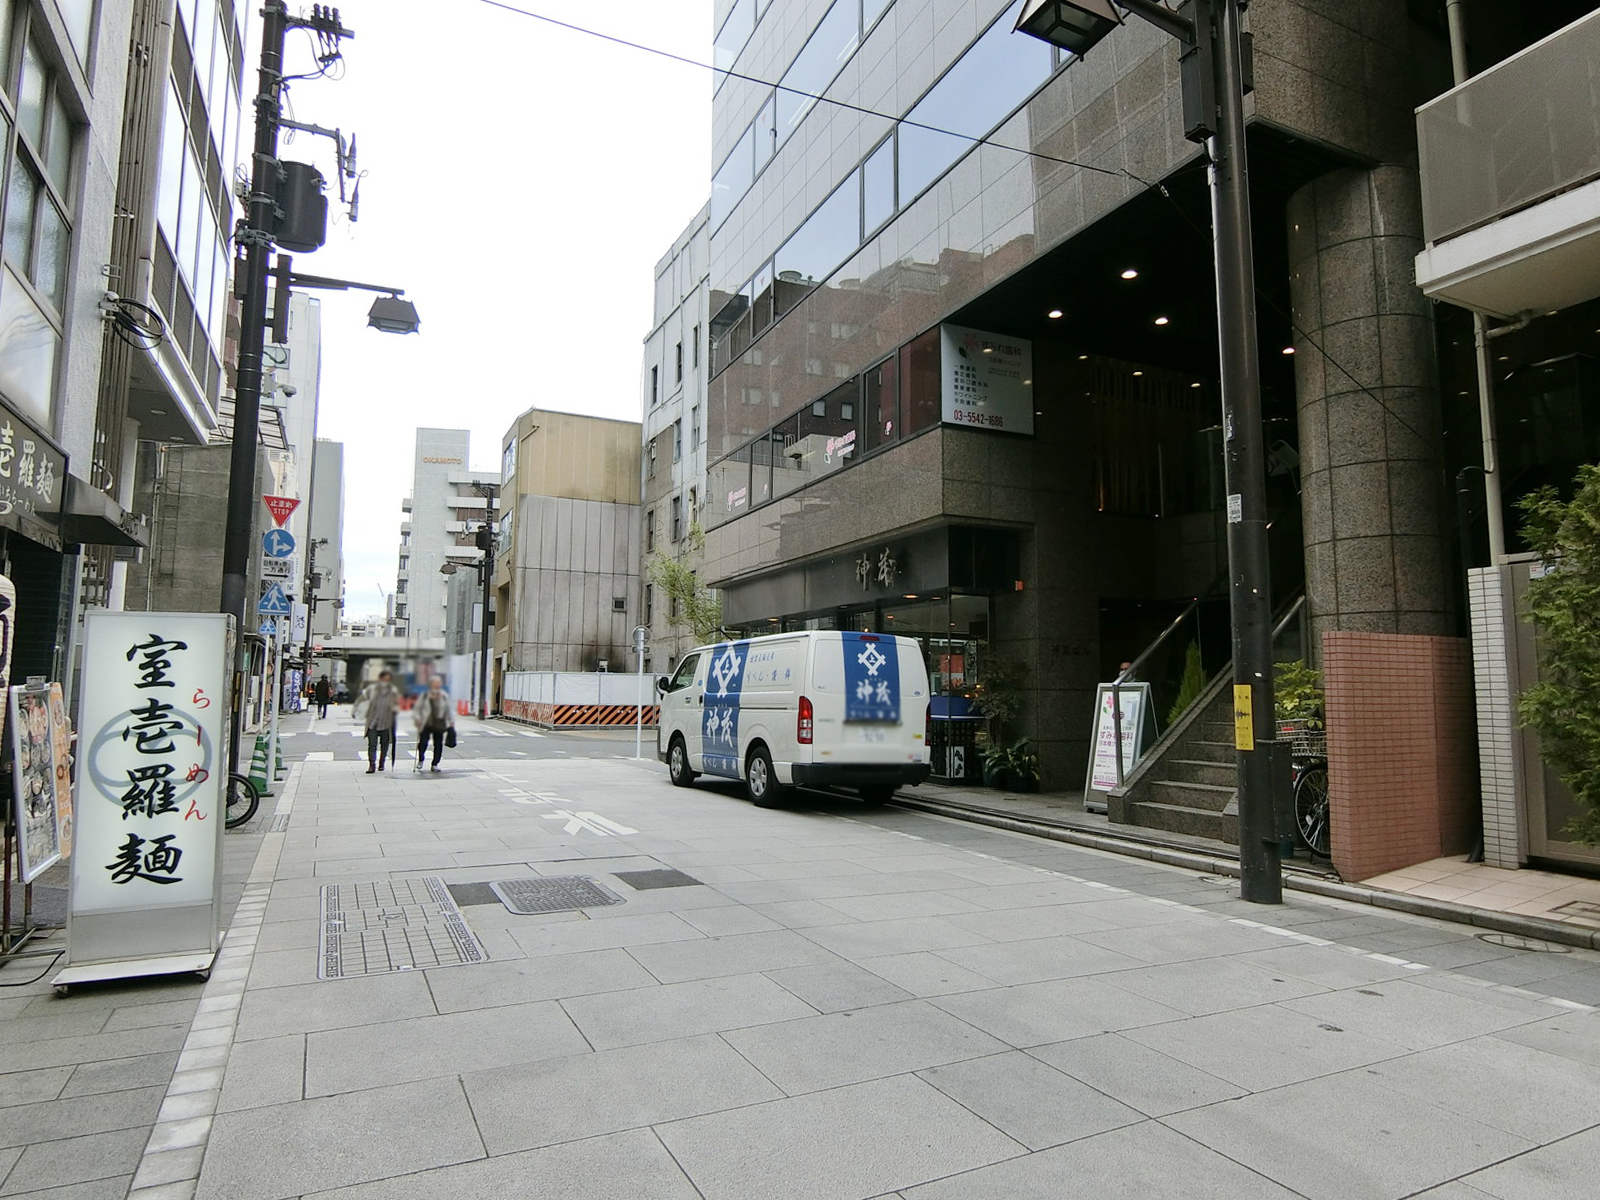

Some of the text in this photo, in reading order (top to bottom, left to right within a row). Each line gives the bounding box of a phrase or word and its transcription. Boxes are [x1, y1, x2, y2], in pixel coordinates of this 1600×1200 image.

[953, 391, 988, 401] ホワイトニング
[953, 410, 1004, 428] 03-5542-1686
[423, 456, 463, 465] OKAMOTO
[270, 499, 293, 508] 止まれ
[1098, 740, 1132, 748] 日本橋クニック
[104, 633, 188, 886] 室壱羅麺
[184, 688, 213, 822] らーめん
